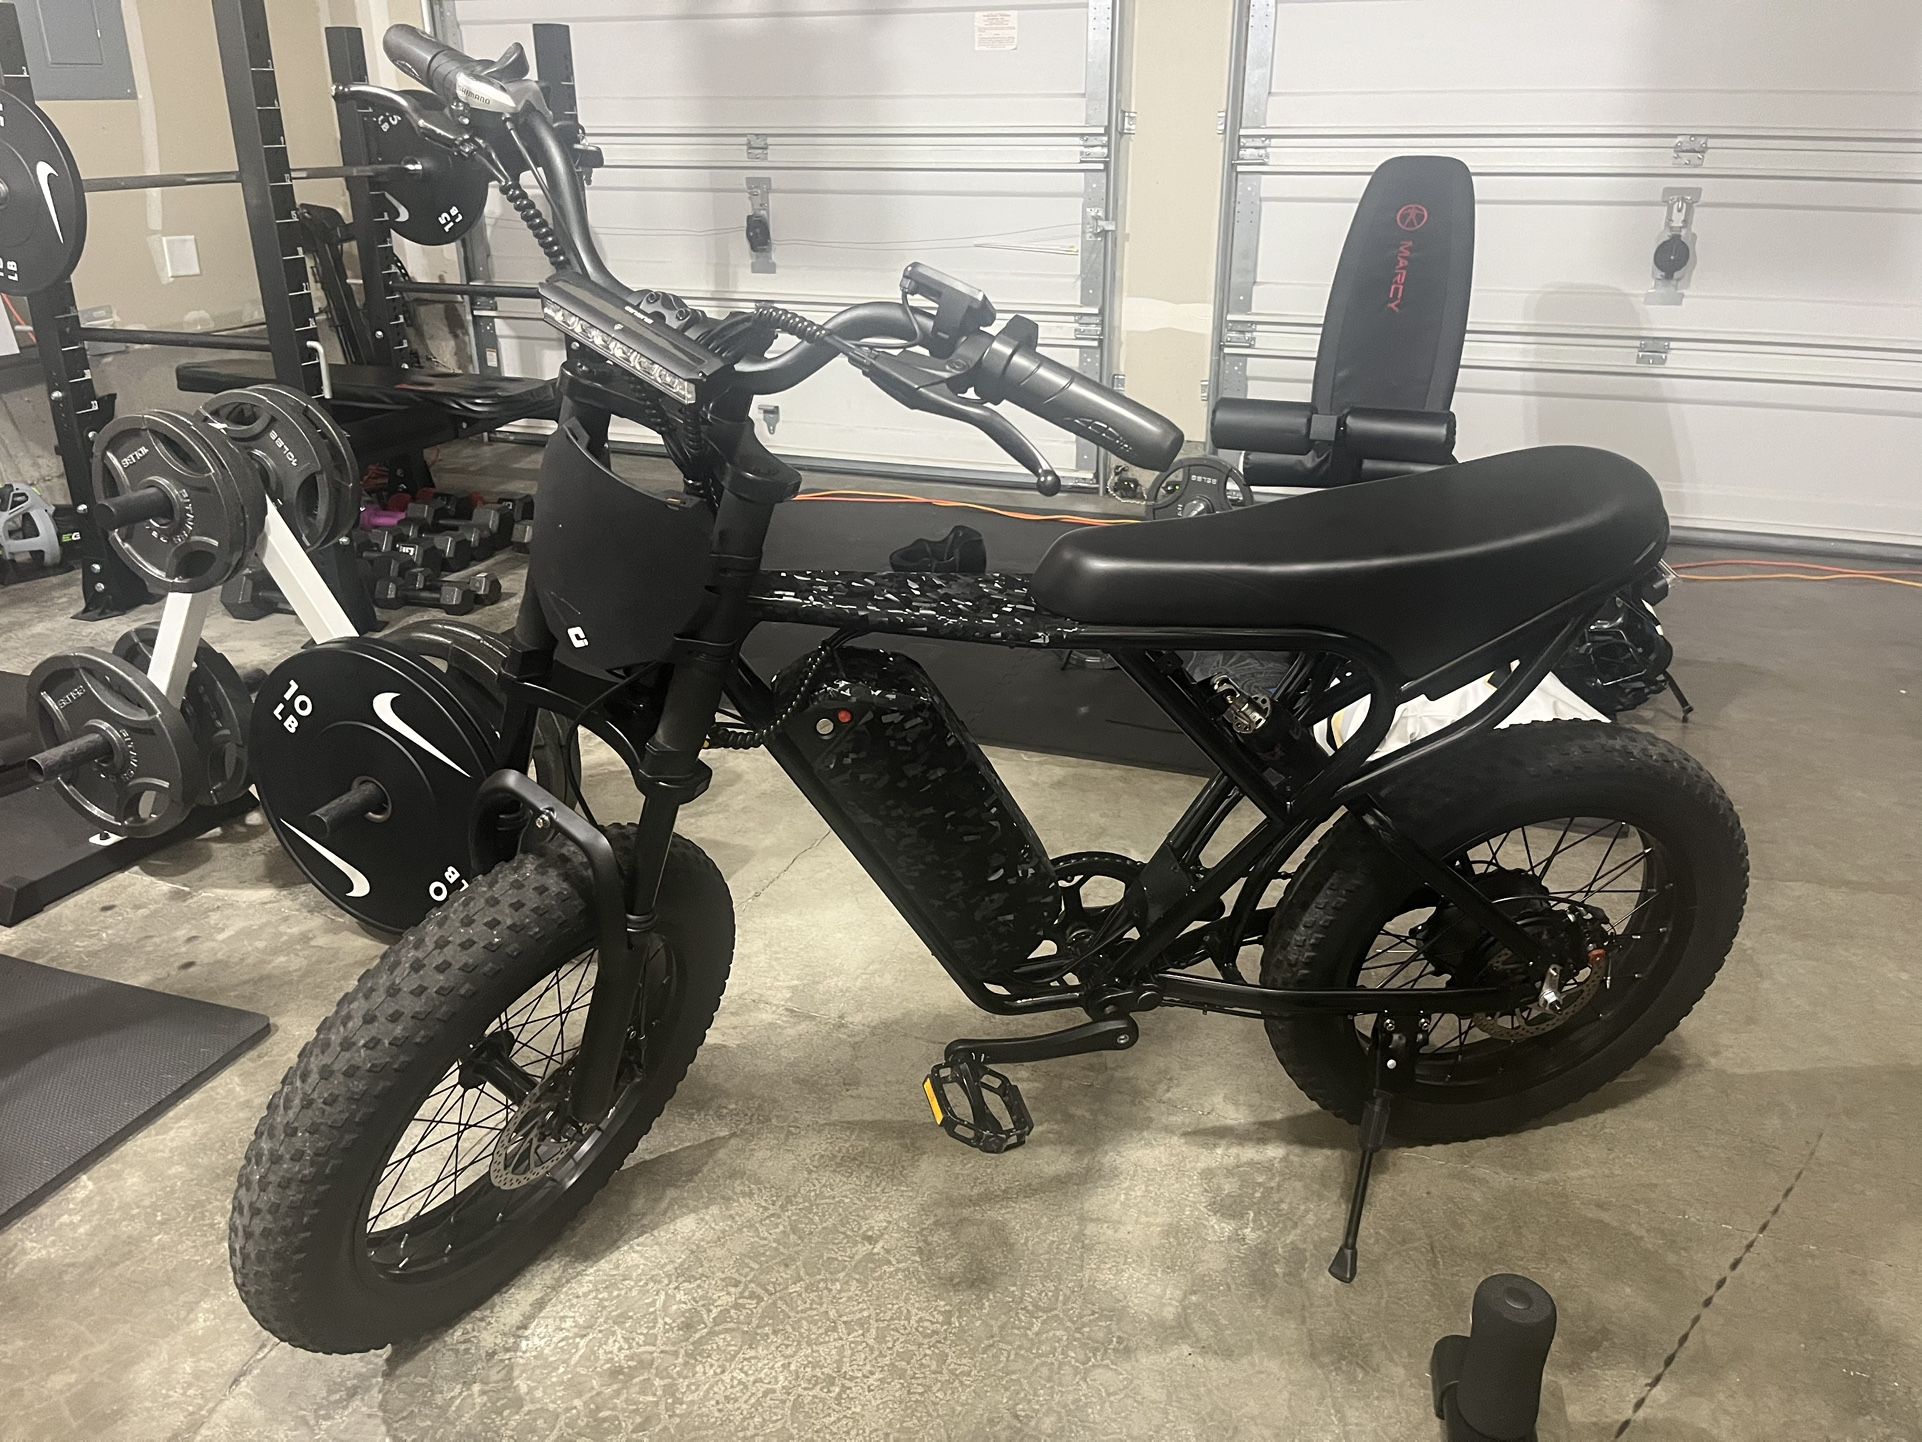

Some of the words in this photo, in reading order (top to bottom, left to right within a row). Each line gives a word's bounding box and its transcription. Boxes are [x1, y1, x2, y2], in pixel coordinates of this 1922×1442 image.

[438, 212, 454, 232] 15
[450, 205, 463, 223] LB
[6, 260, 19, 281] LB
[1387, 240, 1413, 312] MARCY
[283, 679, 313, 717] 10
[273, 702, 299, 733] LB
[444, 865, 470, 892] LB
